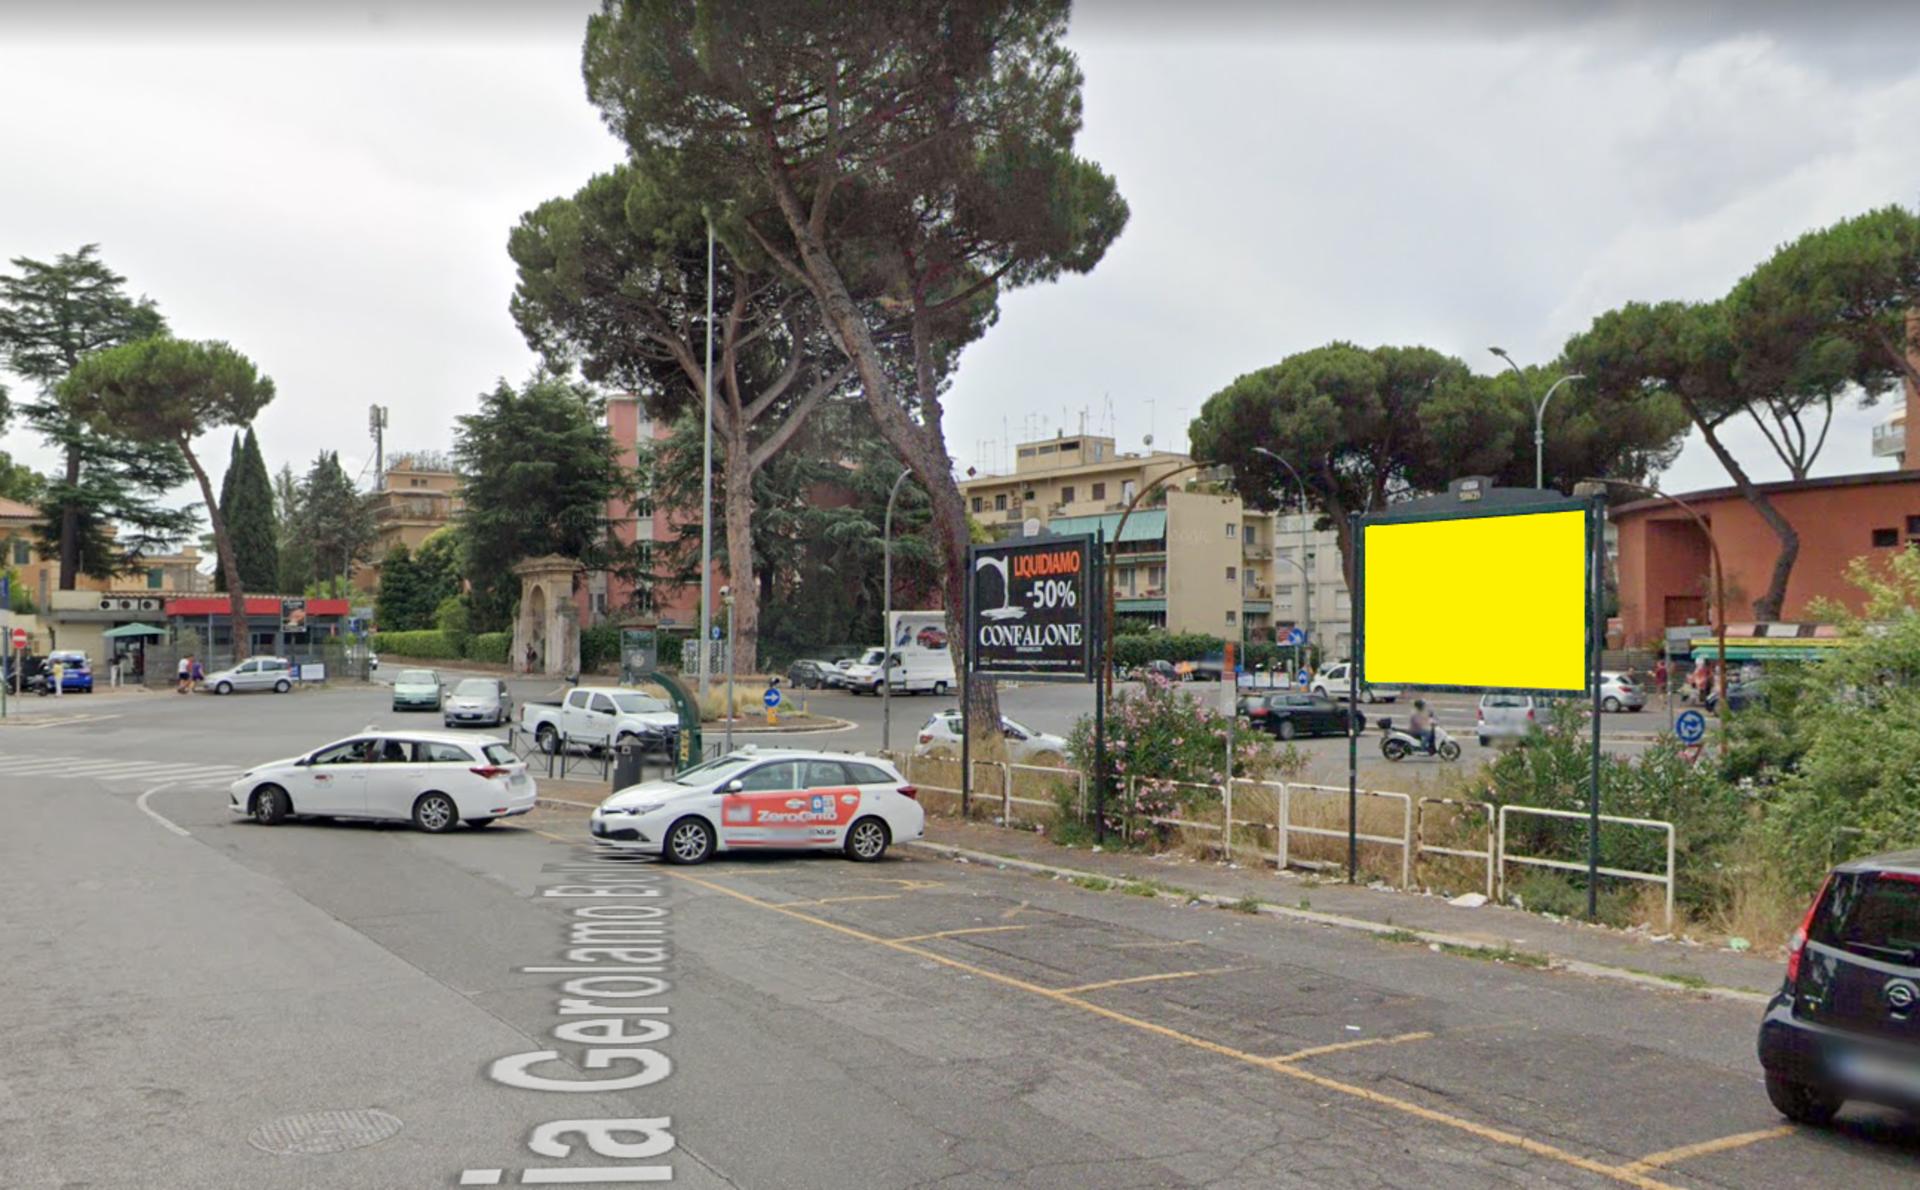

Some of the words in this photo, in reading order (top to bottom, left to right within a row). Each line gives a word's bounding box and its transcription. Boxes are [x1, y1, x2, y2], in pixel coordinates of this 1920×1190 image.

[1014, 551, 1080, 577] LIQUIDIAMO
[1026, 579, 1076, 609] -50%
[979, 623, 1083, 646] CONFALONE
